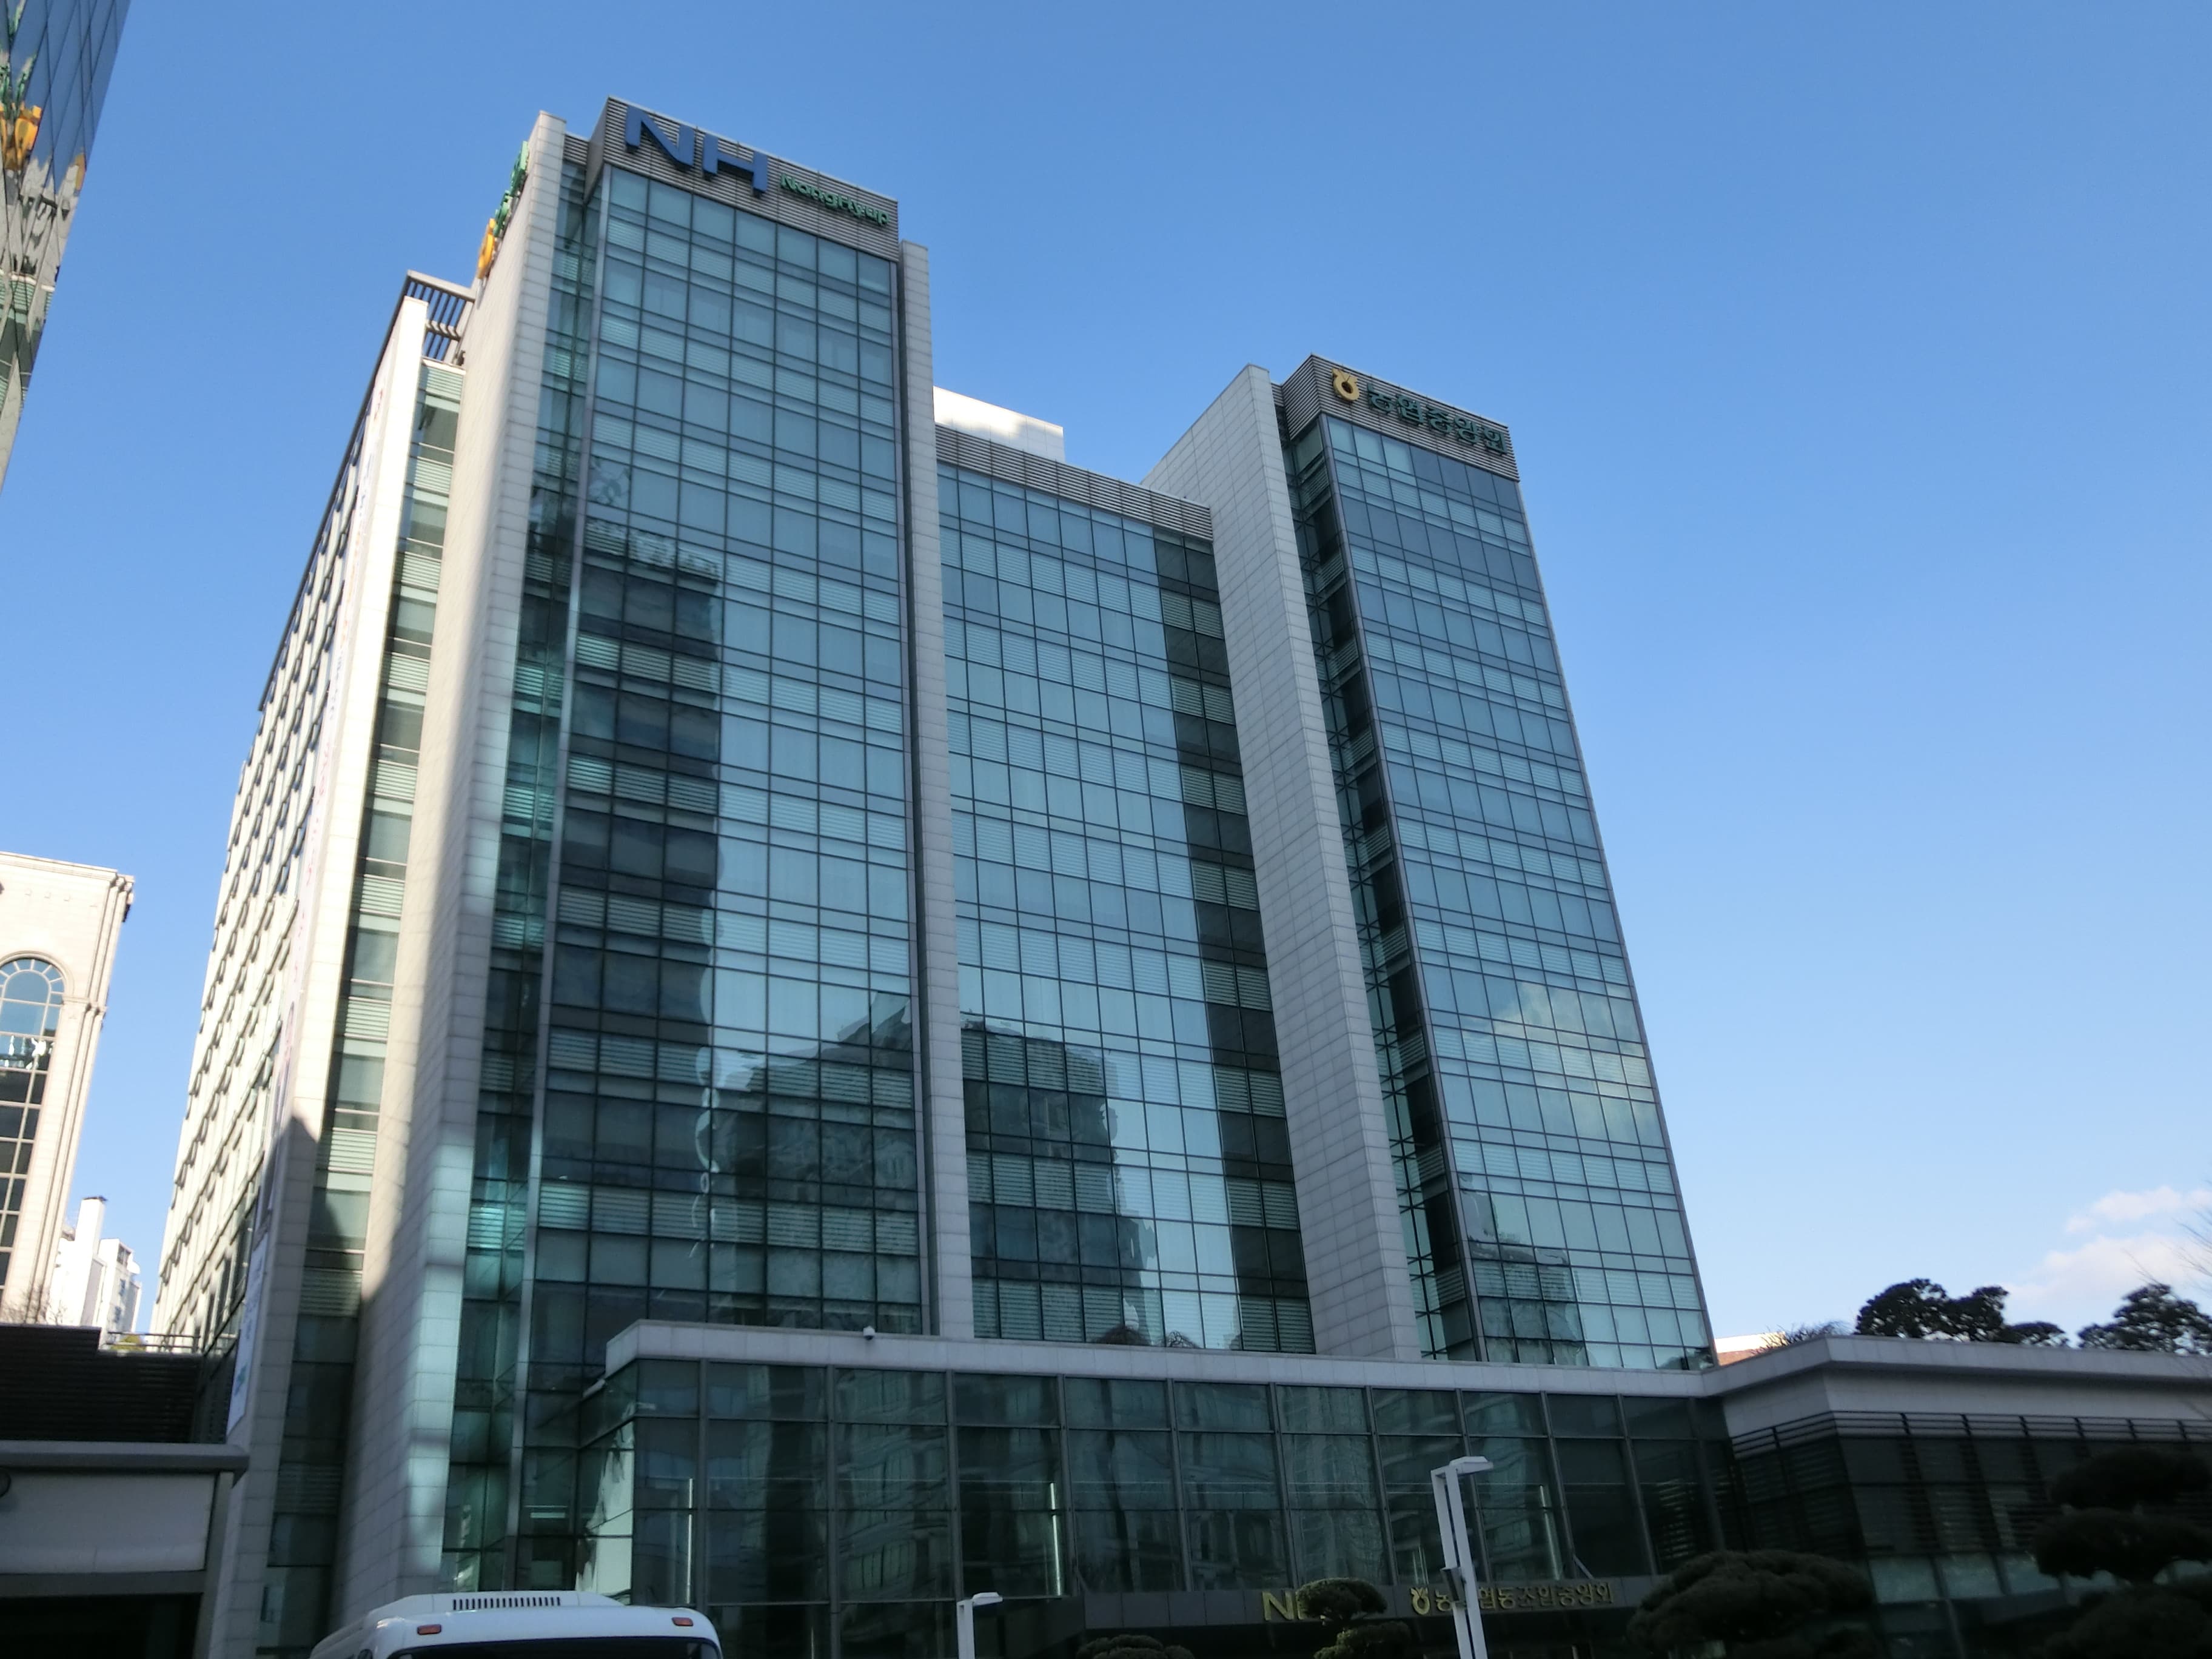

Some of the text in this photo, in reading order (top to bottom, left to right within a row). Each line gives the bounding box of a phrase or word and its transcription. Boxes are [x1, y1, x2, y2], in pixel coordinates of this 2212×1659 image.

[625, 105, 768, 195] NH
[1366, 381, 1509, 455] 농협중앙회
[1261, 1590, 1326, 1621] N
[1435, 1581, 1614, 1612] 농협동조합중앙회
